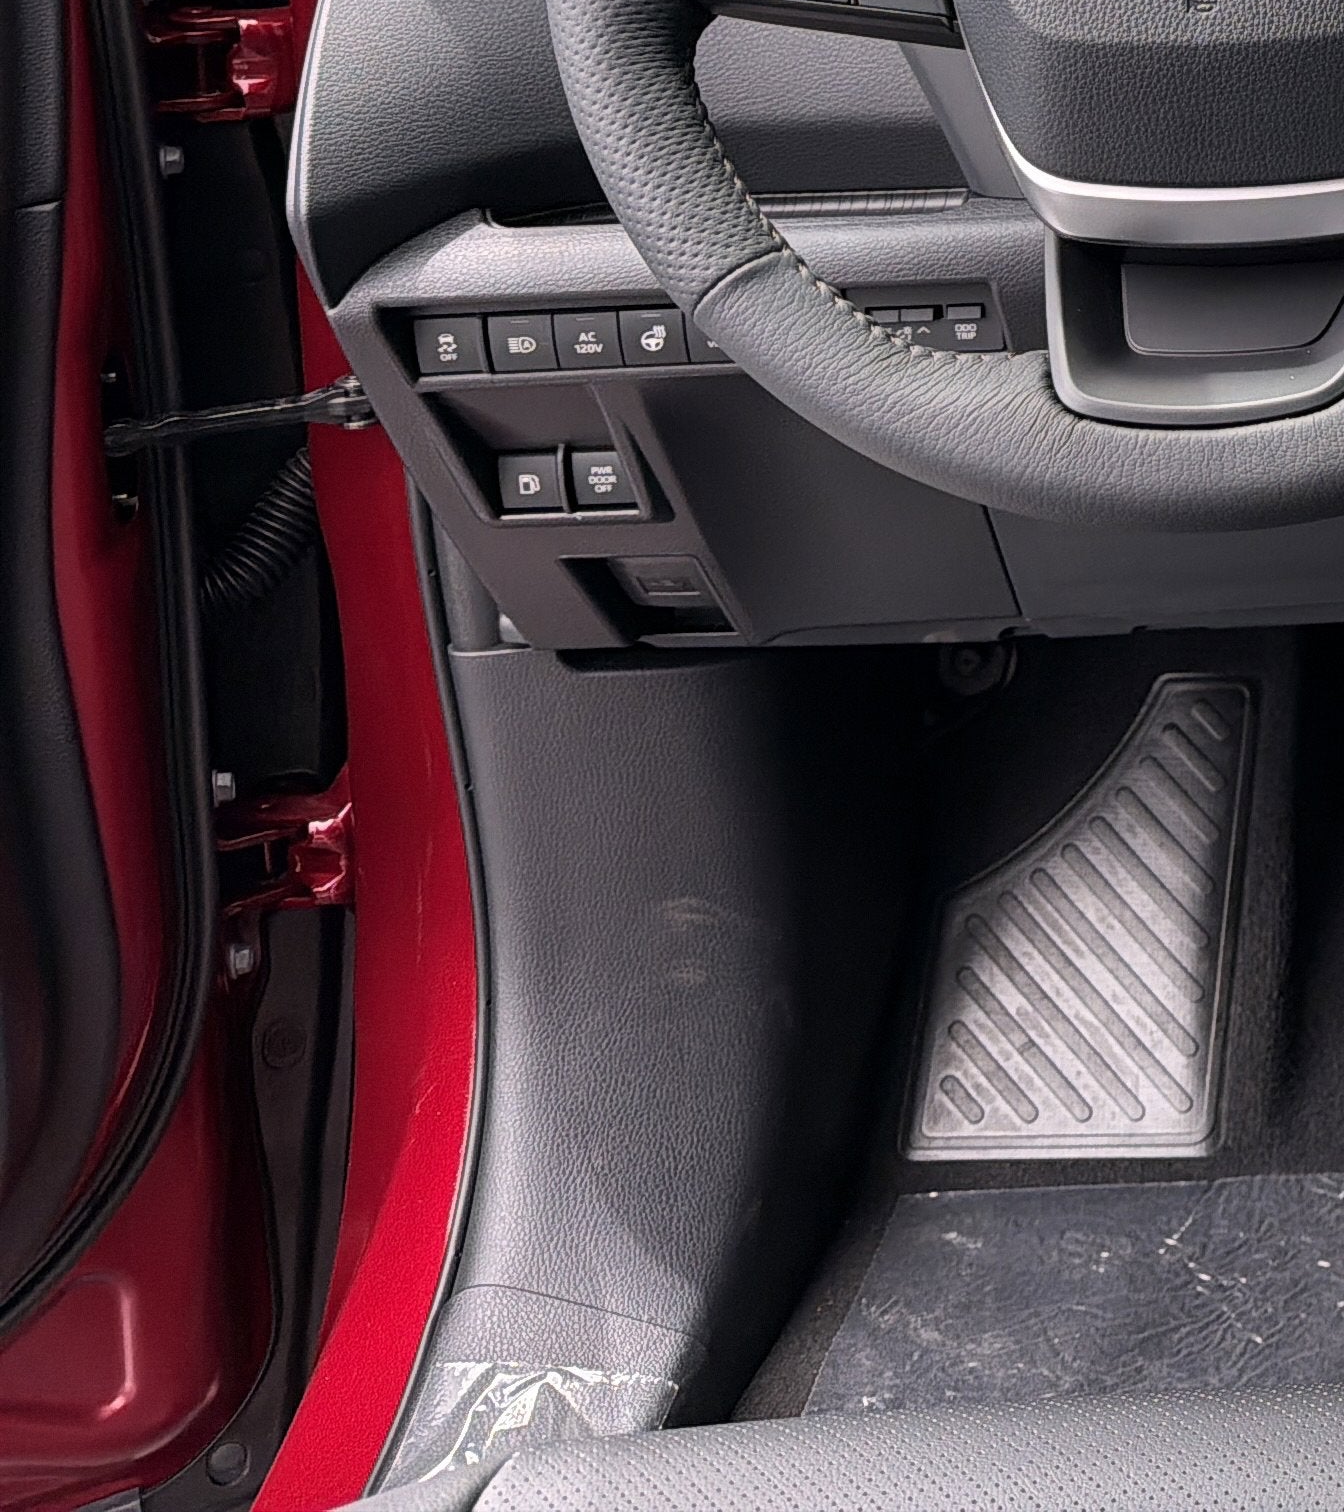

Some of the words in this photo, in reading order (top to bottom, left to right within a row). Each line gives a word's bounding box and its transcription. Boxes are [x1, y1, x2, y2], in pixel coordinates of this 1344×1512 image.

[954, 323, 977, 332] ODO
[579, 332, 597, 342] AC
[955, 331, 977, 340] TRIP
[574, 343, 604, 354] 120V
[440, 352, 458, 362] OFF
[590, 466, 613, 475] PWR
[588, 475, 617, 484] DOOR
[594, 484, 613, 493] OFF
